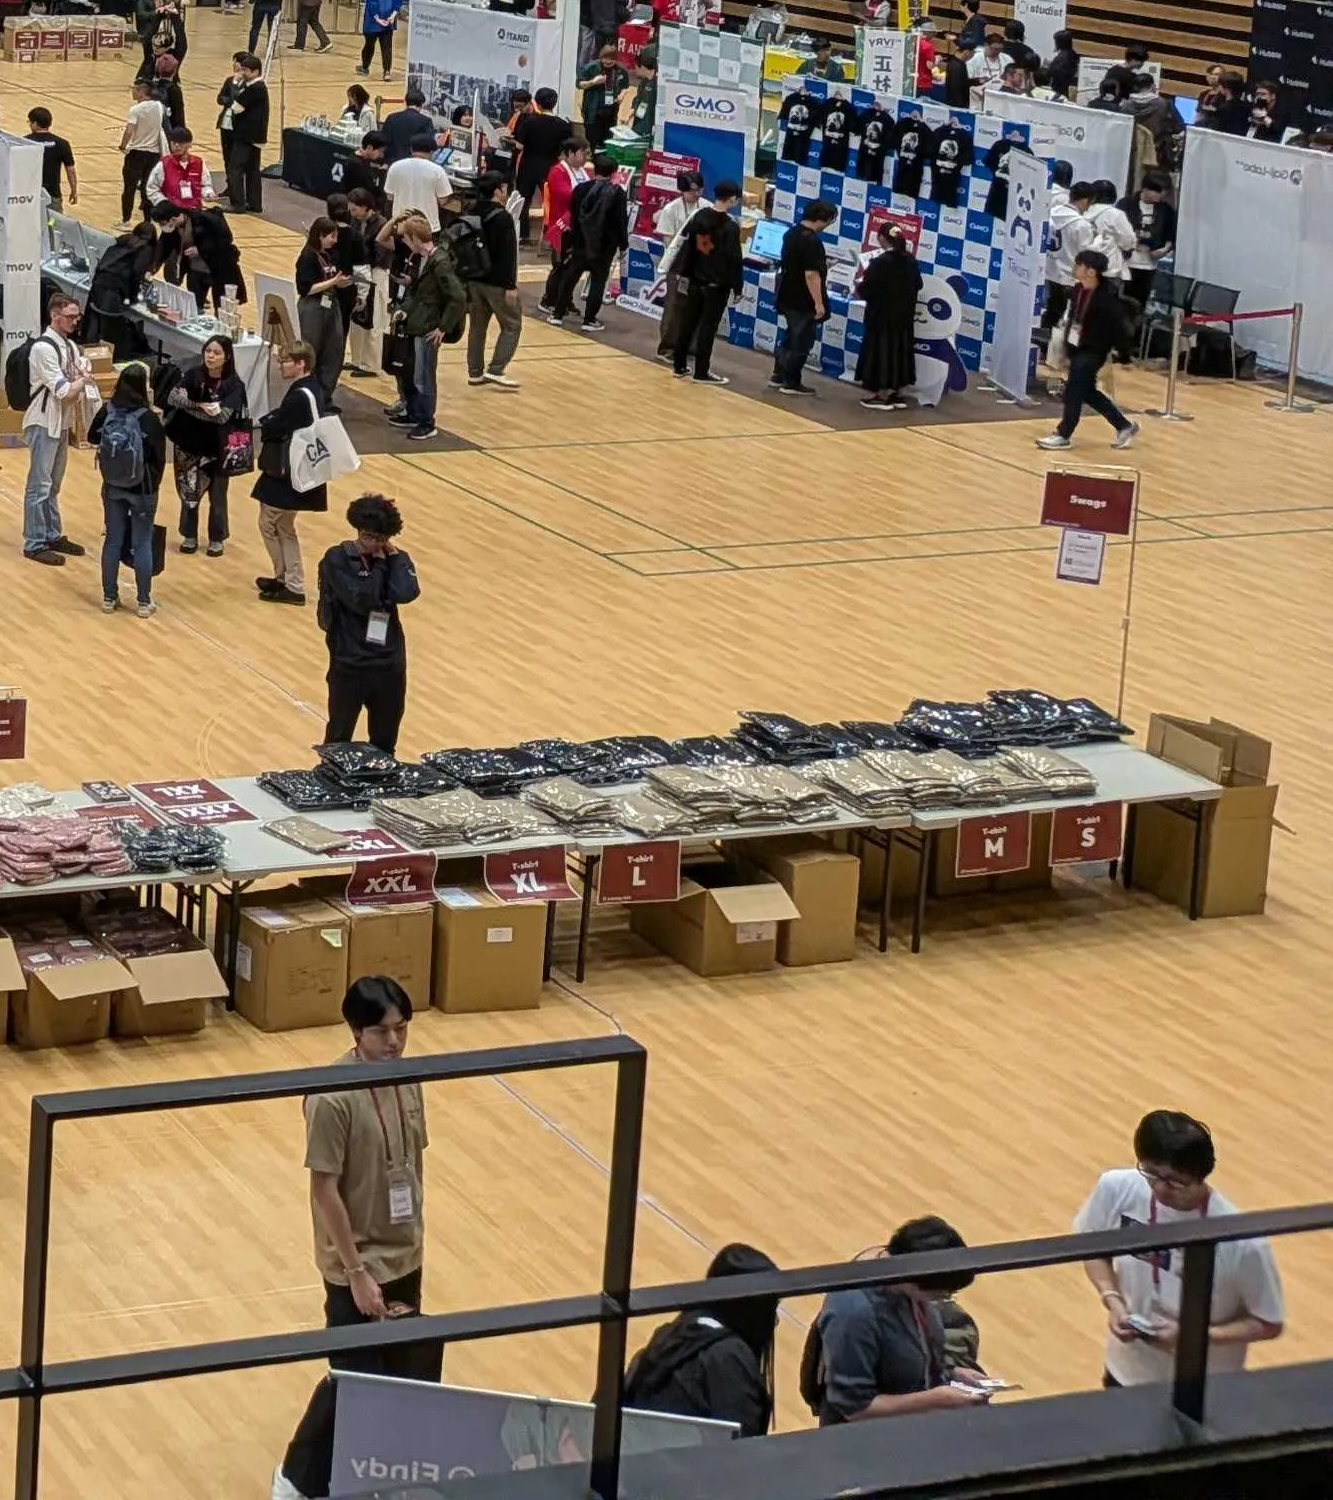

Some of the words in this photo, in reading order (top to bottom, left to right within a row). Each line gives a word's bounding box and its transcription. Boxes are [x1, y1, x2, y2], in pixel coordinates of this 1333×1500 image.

[675, 93, 735, 114] GMO
[674, 108, 707, 118] INTERNET
[708, 113, 736, 122] GROUP
[7, 195, 33, 204] mov
[6, 263, 33, 272] mov
[6, 330, 33, 340] mov
[1070, 495, 1107, 509] Swags
[1076, 816, 1101, 825] T-shirt
[983, 826, 1007, 836] T-shirt
[1081, 827, 1096, 848] S
[984, 837, 1004, 859] M
[512, 860, 539, 870] T-shirt
[628, 855, 654, 864] T-shirt
[382, 867, 410, 877] T-shirt
[633, 867, 646, 886] L
[363, 875, 417, 894] XXL
[510, 872, 548, 893] XL
